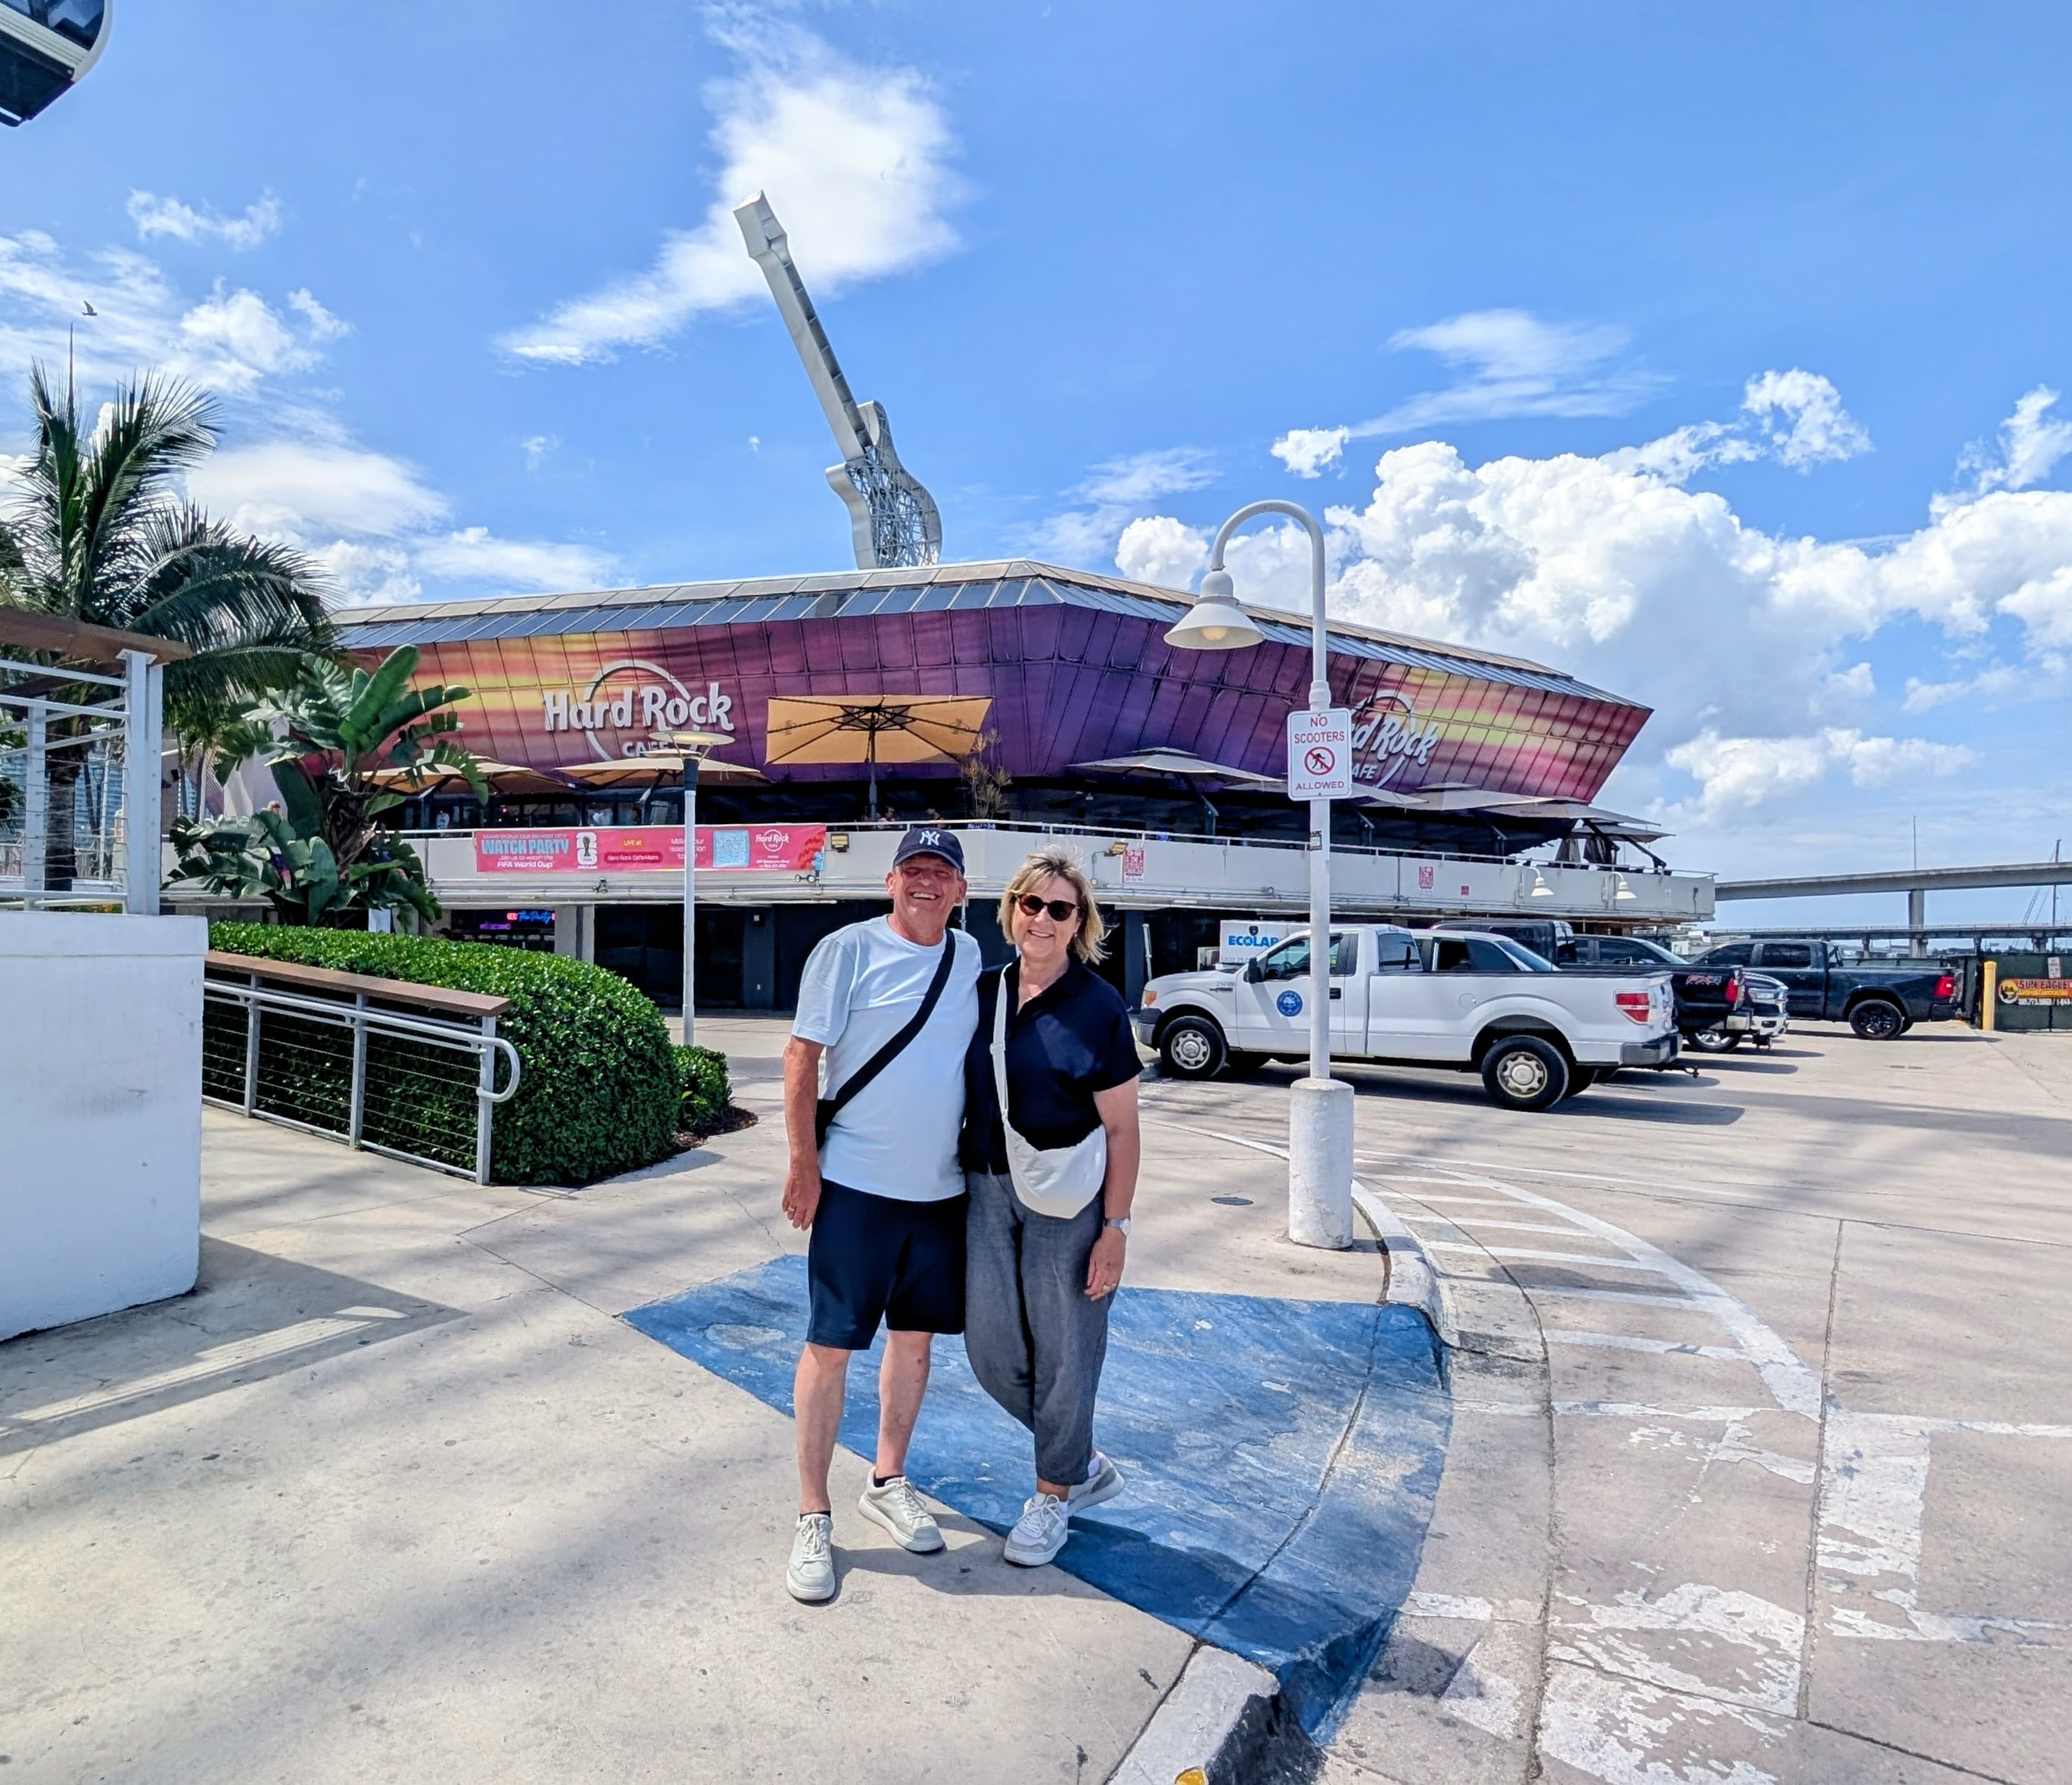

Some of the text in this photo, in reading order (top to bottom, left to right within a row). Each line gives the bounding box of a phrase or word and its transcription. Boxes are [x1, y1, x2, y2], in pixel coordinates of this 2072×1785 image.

[543, 682, 734, 731] Hard Rock
[1310, 717, 1328, 727] NO
[1294, 731, 1345, 744] SCOOTERS
[1372, 718, 1439, 765] Rock
[1352, 763, 1377, 779] AFE
[1296, 781, 1345, 790] ALLOWED
[756, 833, 790, 843] Hard Rock
[919, 830, 940, 846] NY
[481, 839, 570, 854] WATCH PARTY
[530, 911, 552, 924] Party
[2019, 980, 2068, 989] SUN EAGLE
